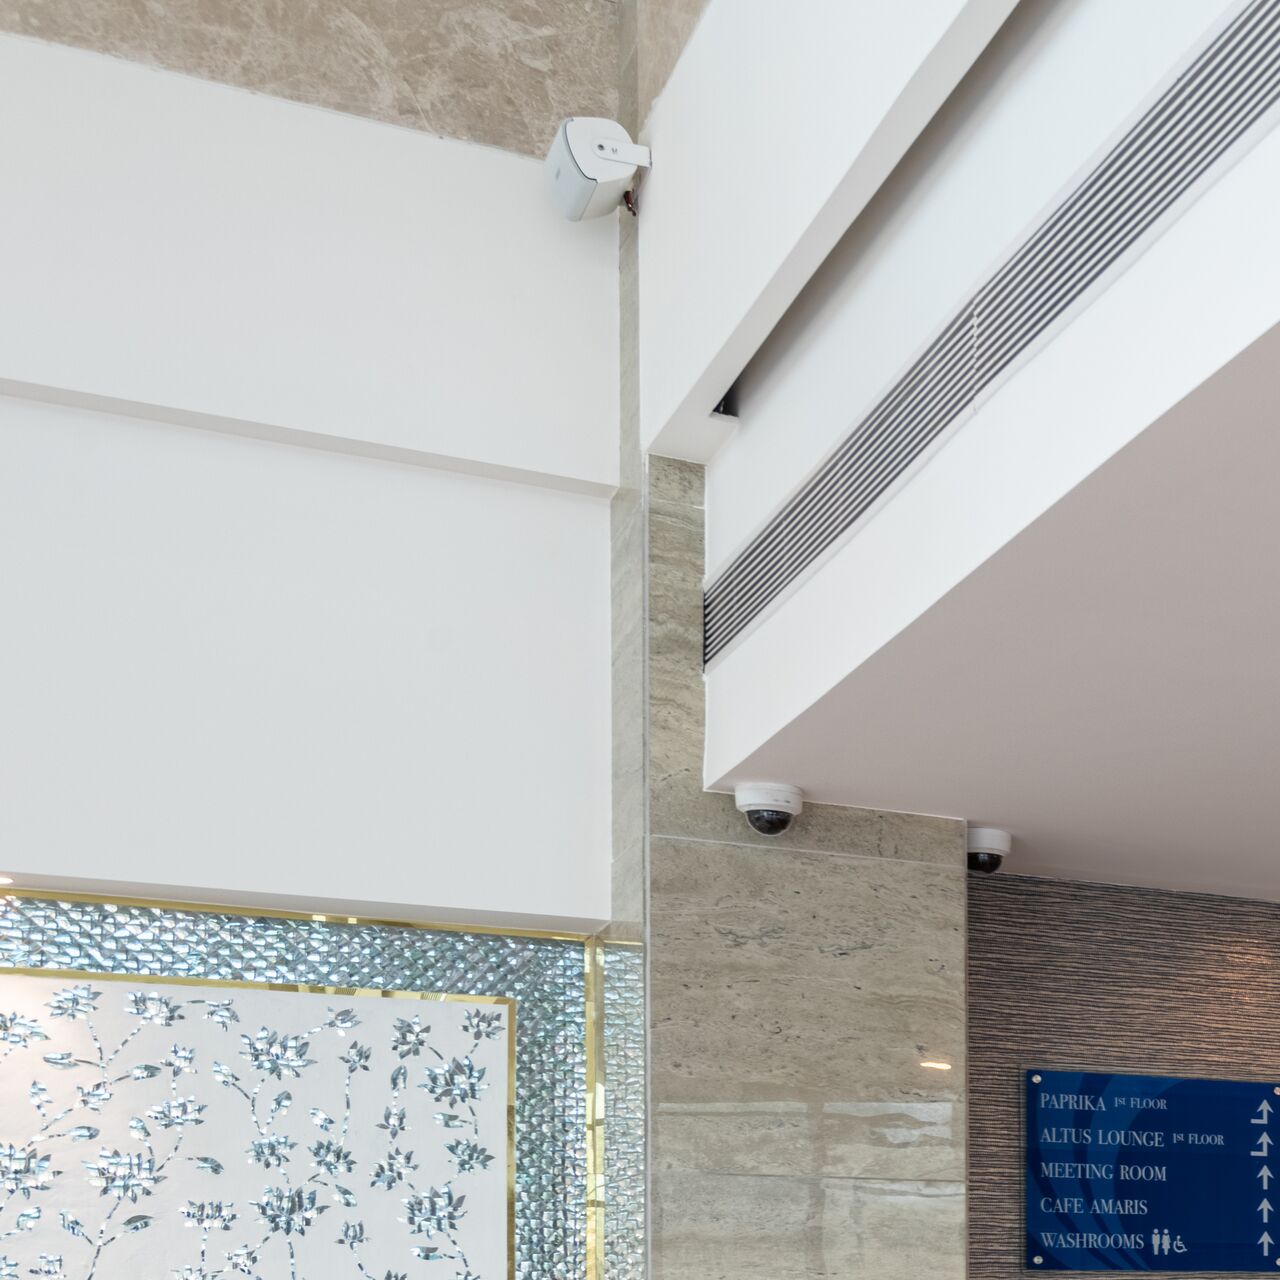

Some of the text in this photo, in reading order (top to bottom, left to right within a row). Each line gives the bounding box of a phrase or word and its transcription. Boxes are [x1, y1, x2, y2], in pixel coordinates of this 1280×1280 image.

[1040, 1093, 1167, 1111] PAPRIKA 1st FLOOR
[1040, 1127, 1225, 1147] ALTUS LOUNGE 1st FLOOR
[1040, 1162, 1167, 1182] MEETING ROOM
[1040, 1197, 1148, 1215] CAFE AMARIS
[1040, 1232, 1145, 1250] WASHROOMS
